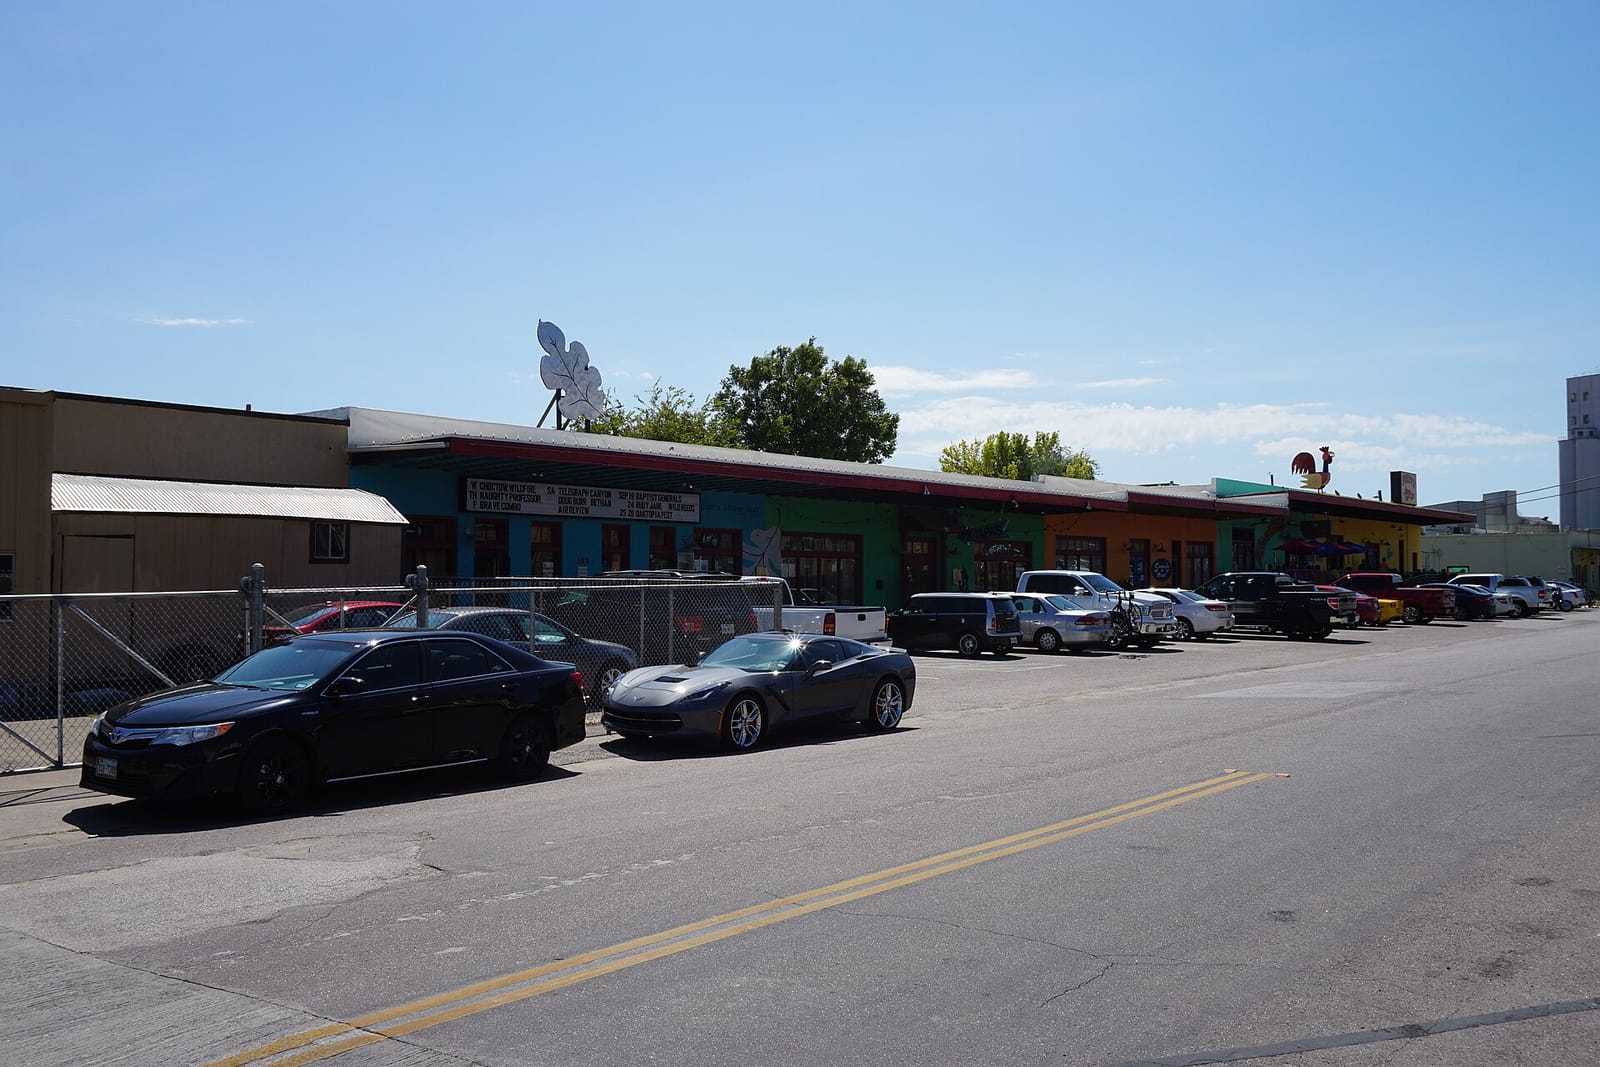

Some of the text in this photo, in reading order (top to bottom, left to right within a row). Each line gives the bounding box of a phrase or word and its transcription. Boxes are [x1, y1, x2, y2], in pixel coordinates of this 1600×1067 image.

[479, 491, 508, 501] NAUGHTY
[508, 493, 541, 503] PROFESSOR
[558, 487, 589, 497] TELEGRAPH
[589, 489, 611, 498] CANYON
[658, 493, 682, 502] GENERALS
[479, 500, 501, 510] BRAVE
